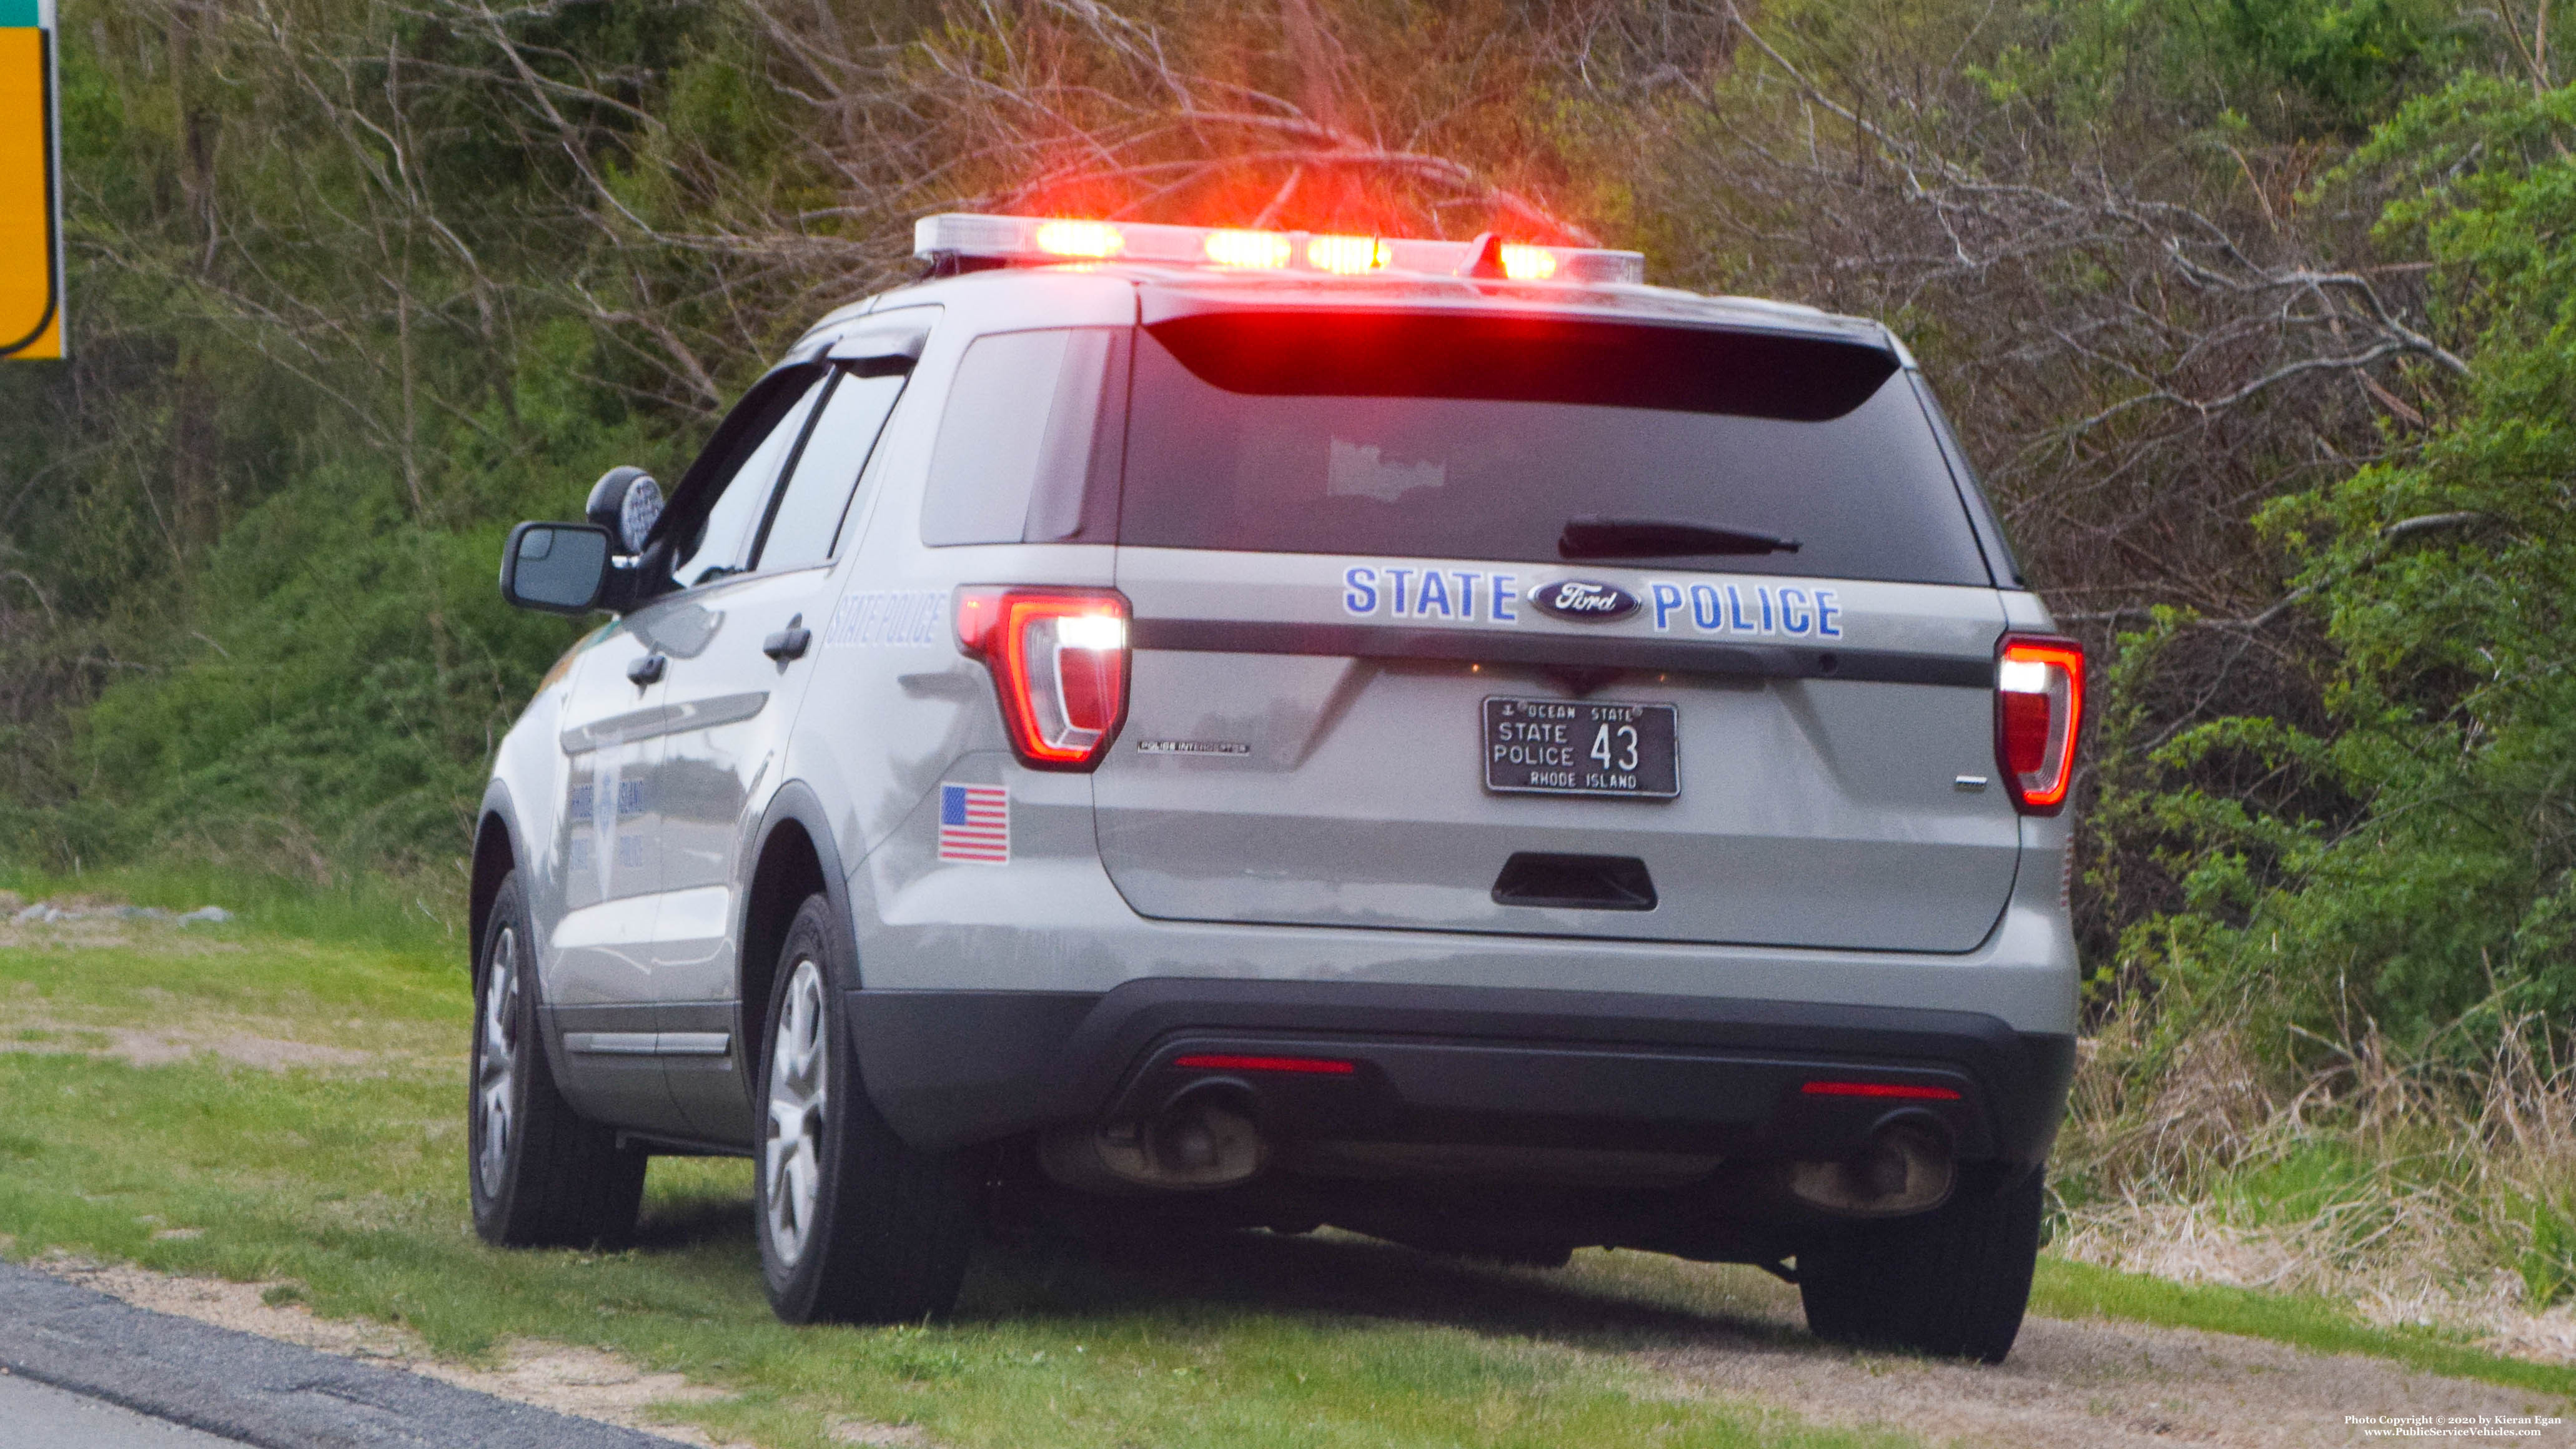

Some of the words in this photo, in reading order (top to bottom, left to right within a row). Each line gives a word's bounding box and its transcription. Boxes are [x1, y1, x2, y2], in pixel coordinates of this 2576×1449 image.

[1344, 565, 1518, 623] STATE
[1650, 581, 1842, 639] POLICE
[1555, 582, 1617, 611] Ford
[825, 593, 884, 645] STATE
[875, 591, 947, 643] POLICE
[1528, 705, 1575, 718] OCEAN
[1591, 707, 1634, 722] STATE
[1499, 722, 1568, 743] STATE
[1494, 744, 1575, 766] POLICE
[1590, 723, 1638, 771] 43
[1530, 771, 1576, 787] RHODE
[1586, 774, 1637, 789] ISLAND
